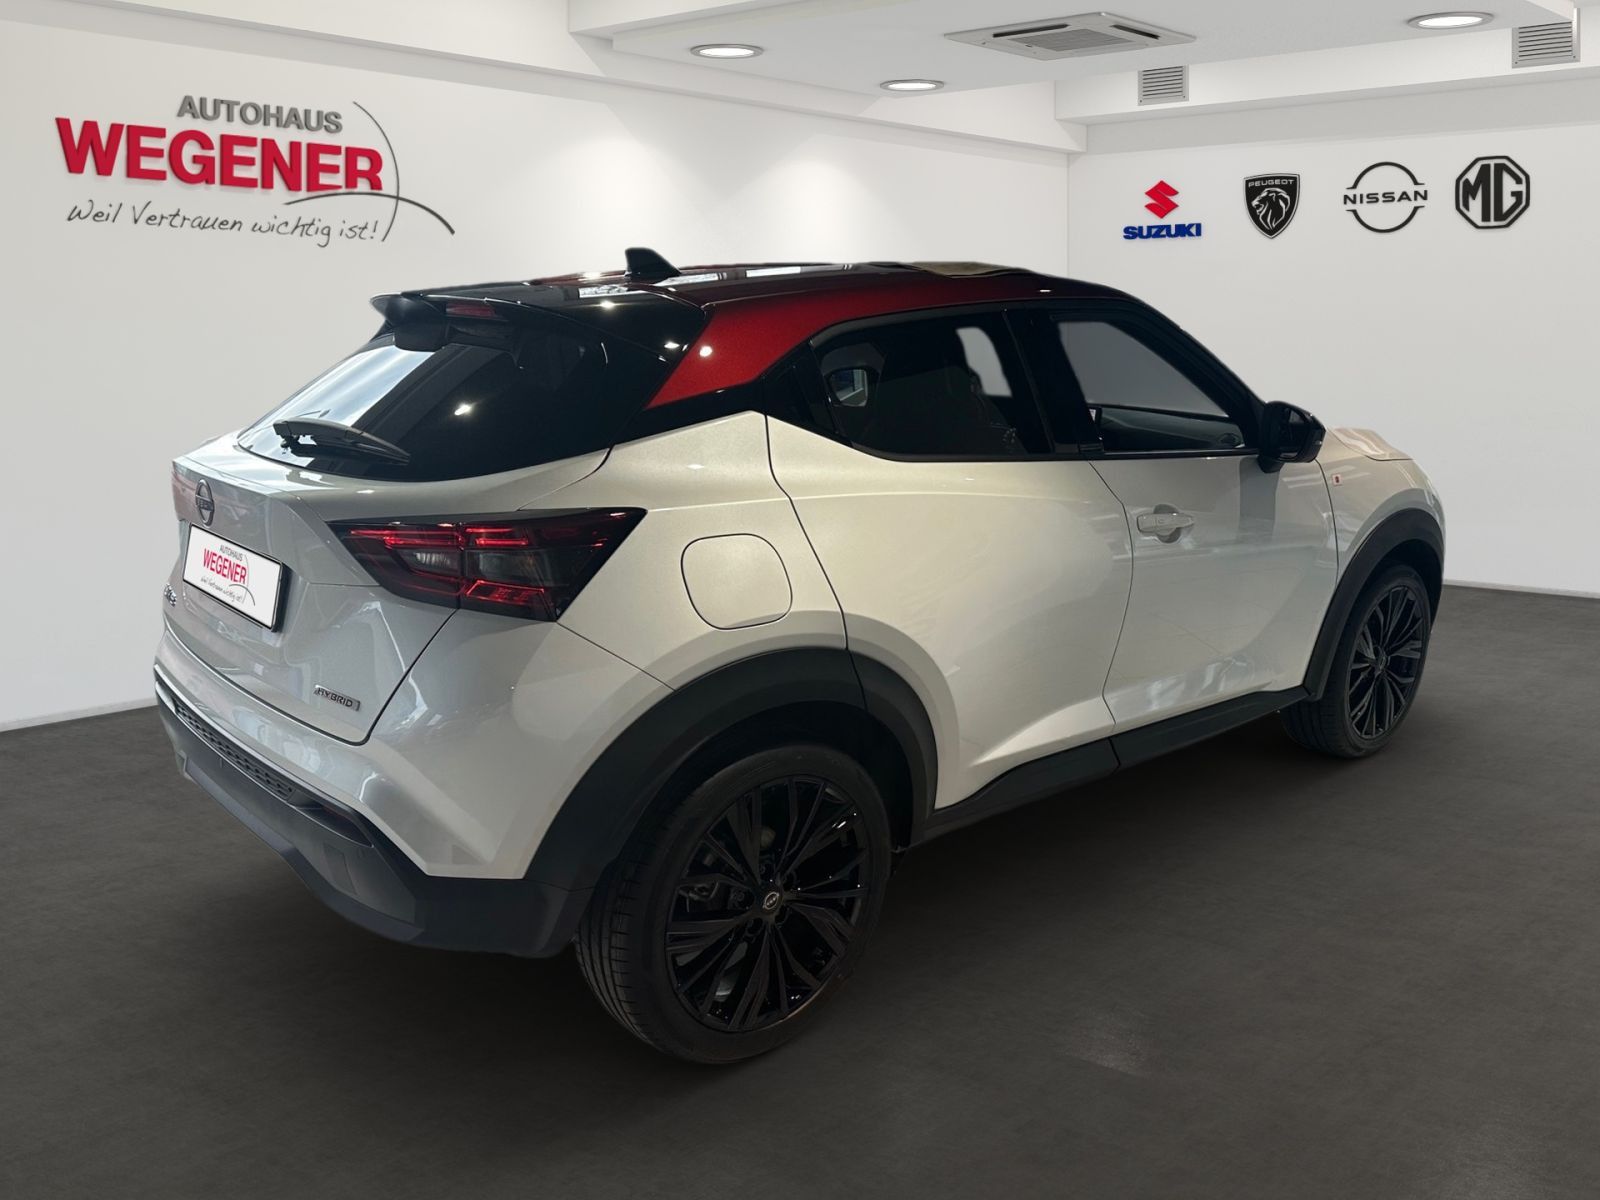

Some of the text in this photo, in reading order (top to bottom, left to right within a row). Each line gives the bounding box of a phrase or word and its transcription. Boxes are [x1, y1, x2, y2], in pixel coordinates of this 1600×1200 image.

[177, 95, 343, 134] AUTOHAUS
[55, 117, 384, 193] WEGENER
[1248, 178, 1295, 188] PEUGEOT
[1343, 190, 1428, 205] NISSAN
[1462, 162, 1523, 222] MG
[67, 199, 378, 248] Weil Vertrauen wichtig ist!
[1123, 223, 1202, 240] SUZUKI
[203, 548, 247, 584] WEGENER
[317, 687, 353, 708] HYBRID
